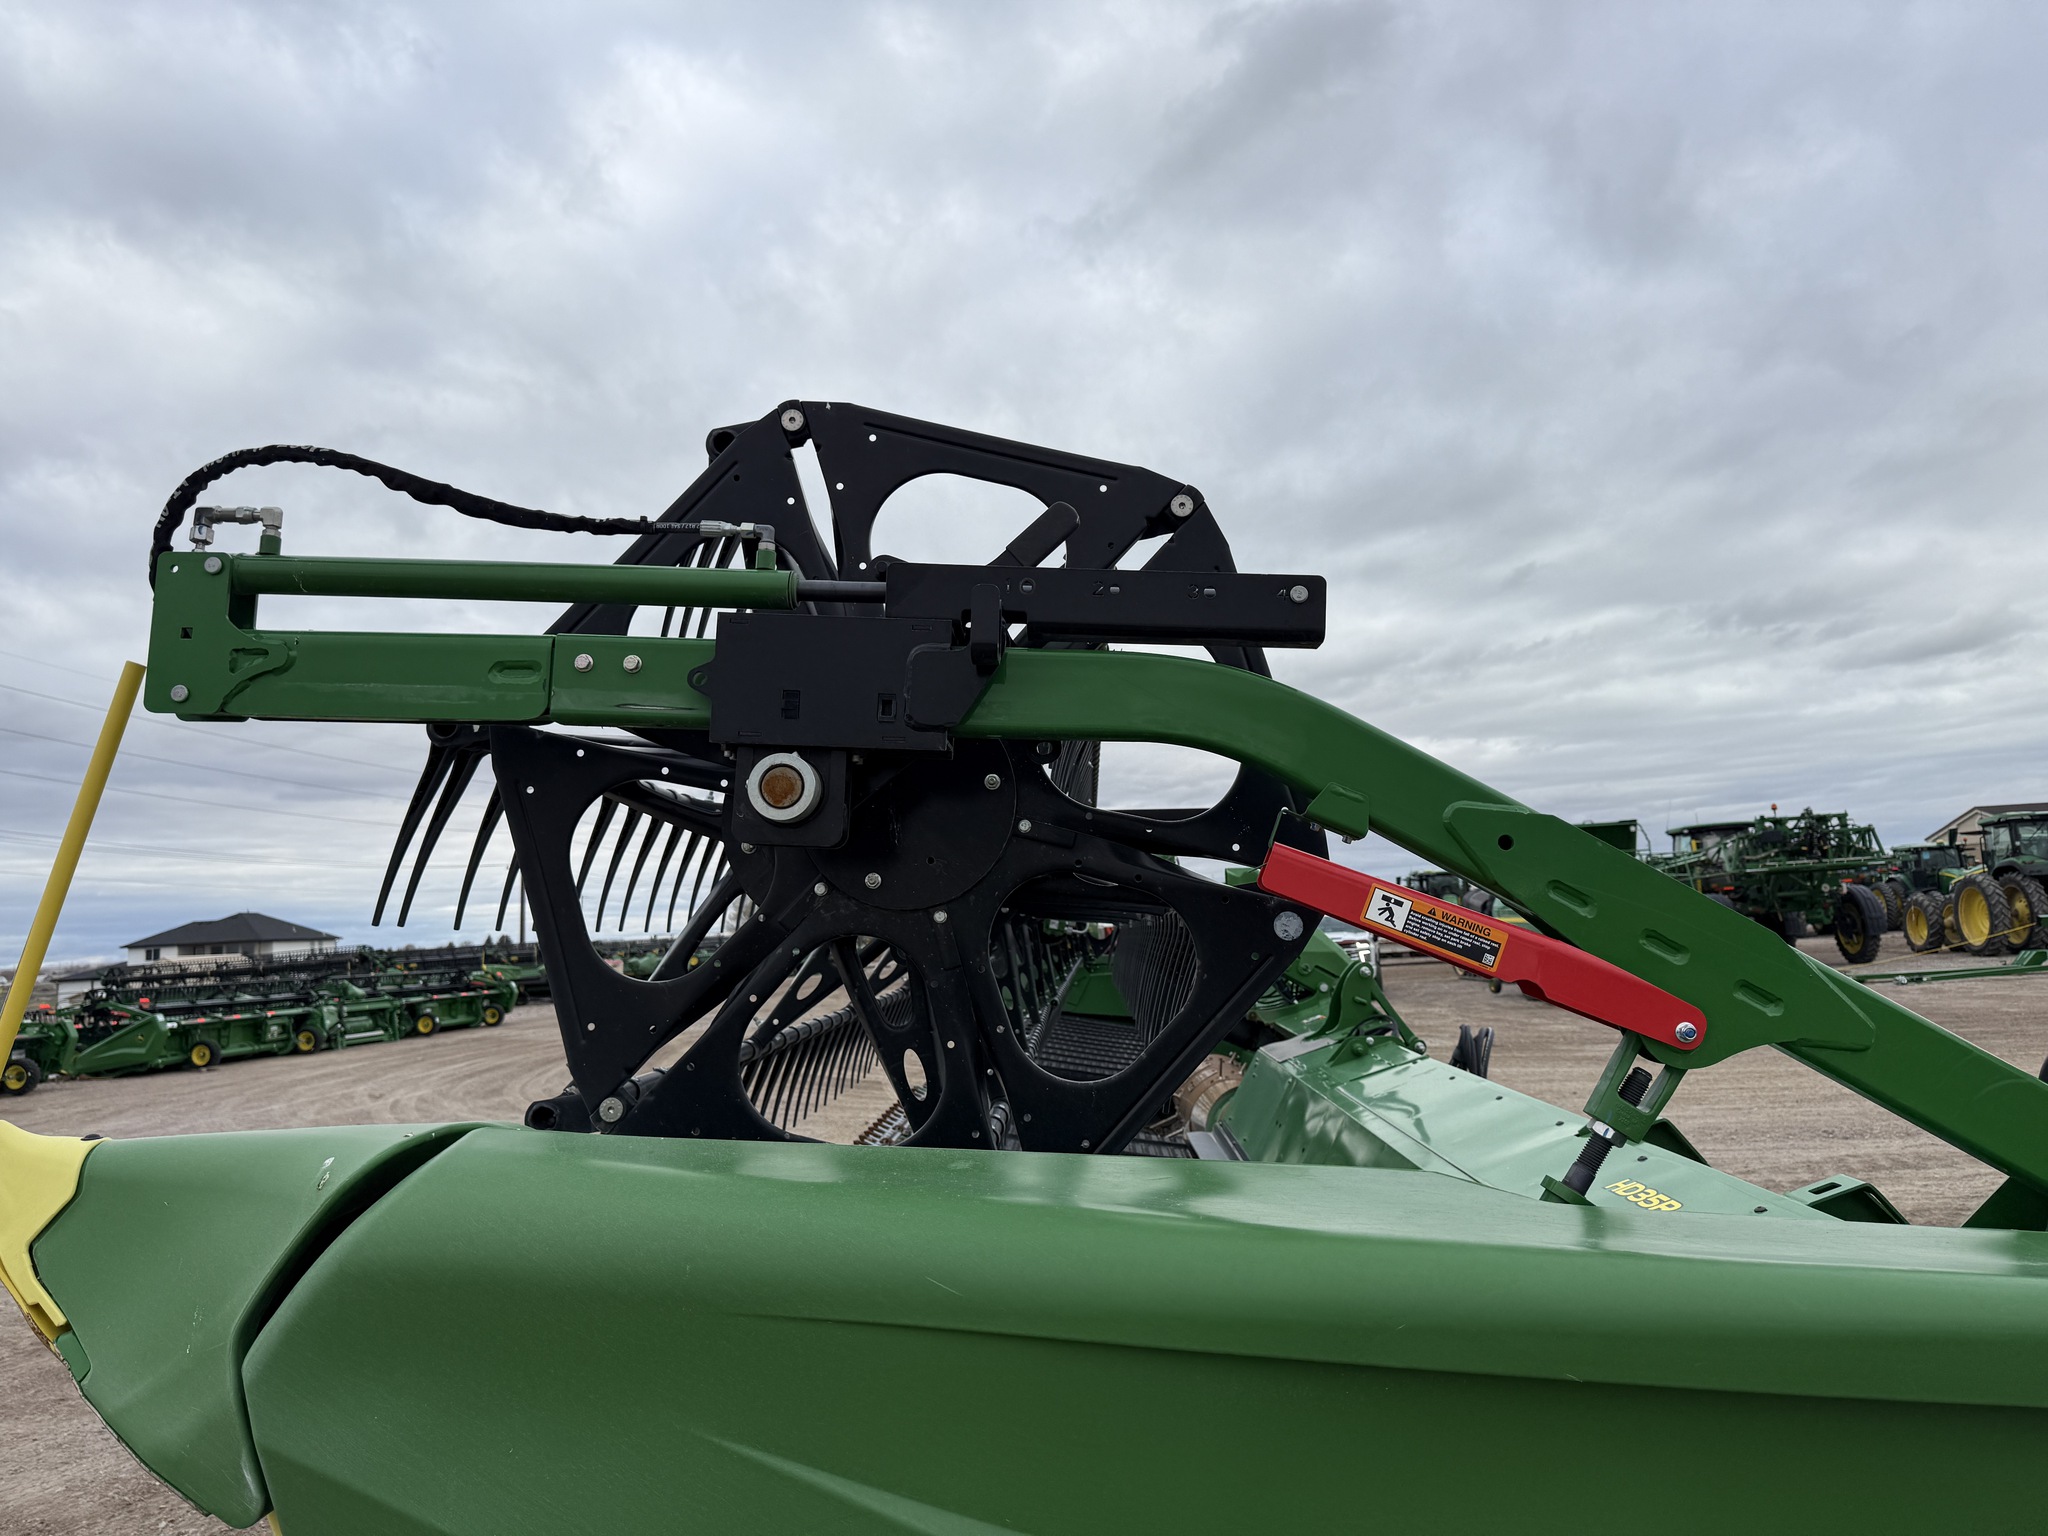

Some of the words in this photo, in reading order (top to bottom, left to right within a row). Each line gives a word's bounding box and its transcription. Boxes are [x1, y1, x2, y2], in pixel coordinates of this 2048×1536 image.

[1092, 580, 1104, 597] 2
[1187, 583, 1200, 600] 3
[1276, 586, 1289, 601] 4
[1409, 915, 1421, 923] Before
[1422, 921, 1437, 930] working
[1422, 916, 1438, 925] crushing
[1439, 922, 1453, 930] injuries
[1442, 911, 1491, 936] WARNING
